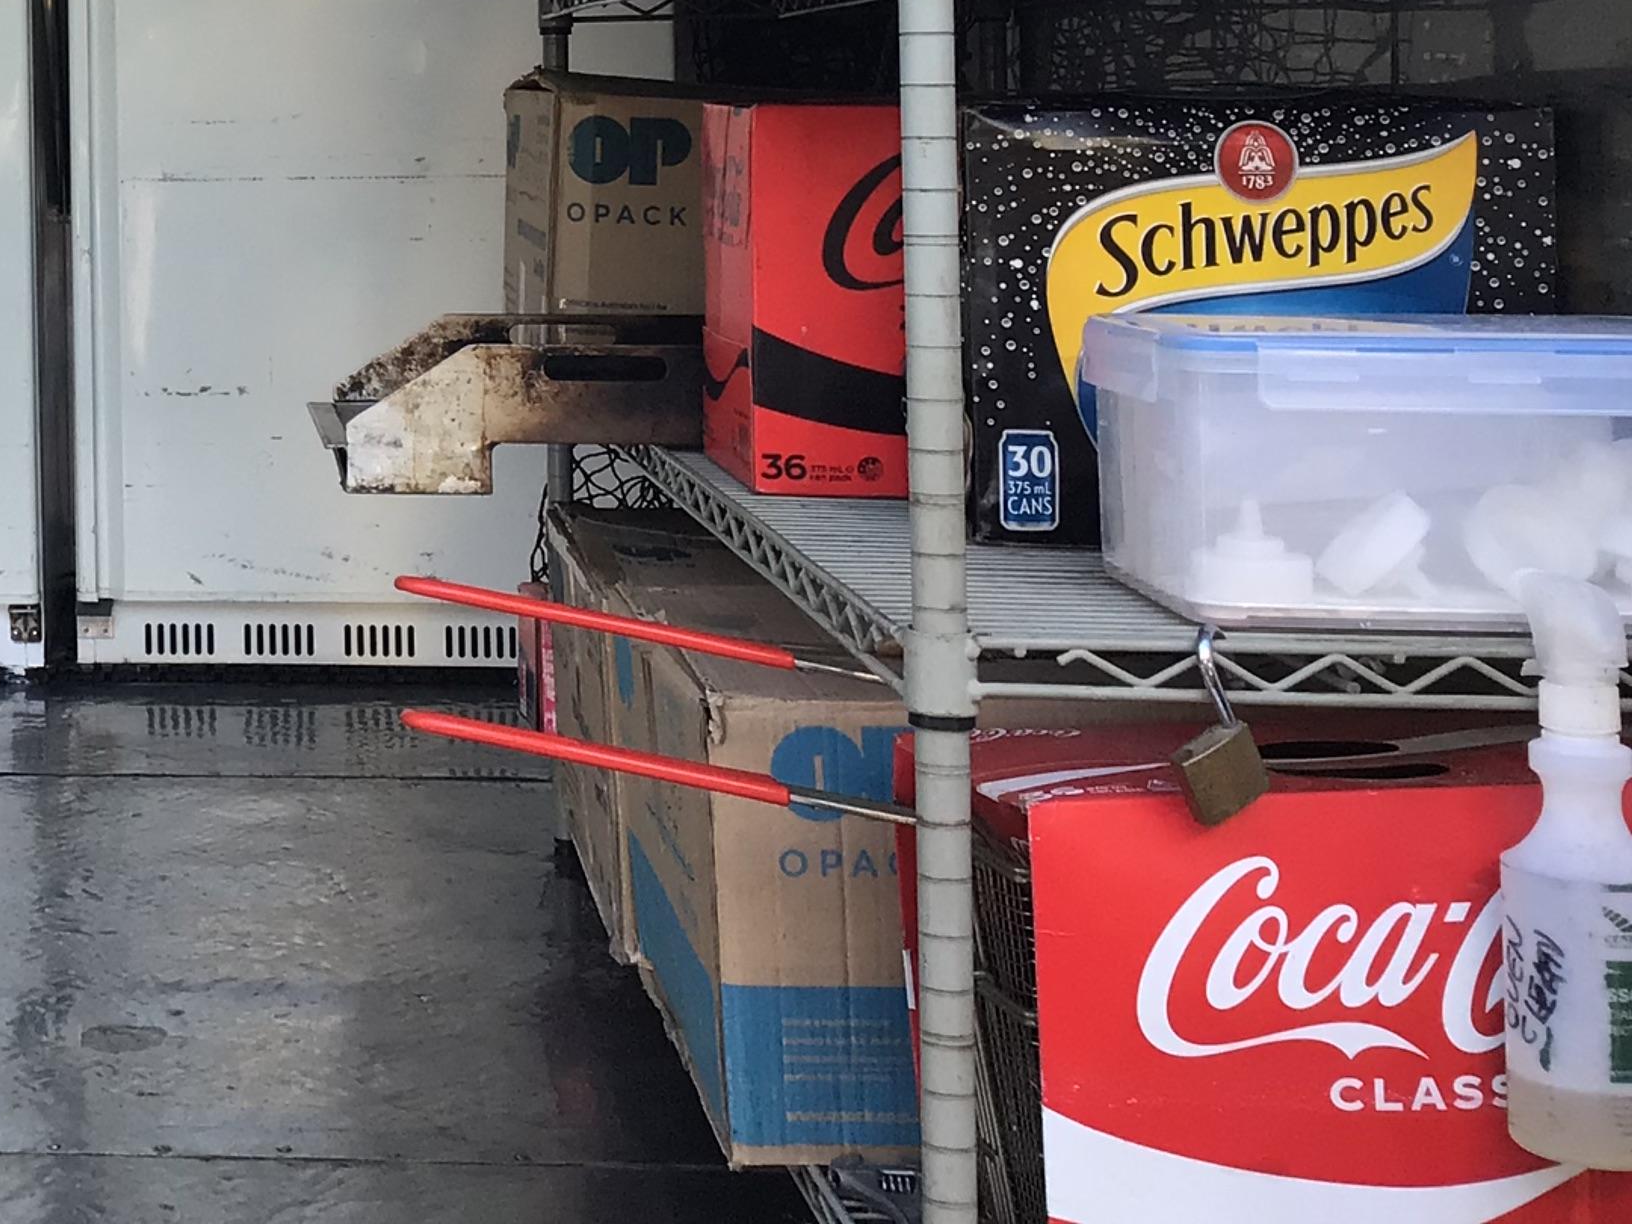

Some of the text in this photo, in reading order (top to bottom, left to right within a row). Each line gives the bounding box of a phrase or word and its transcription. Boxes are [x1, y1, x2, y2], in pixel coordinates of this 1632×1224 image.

[1241, 174, 1274, 190] 1783
[567, 202, 688, 227] OPACK
[1095, 183, 1434, 298] Schweppes
[761, 453, 807, 480] 36
[1007, 445, 1053, 478] 30
[1008, 480, 1053, 494] 375 mL
[1007, 496, 1053, 515] CANS
[778, 849, 898, 878] OPA
[1328, 1074, 1509, 1112] CLASS
